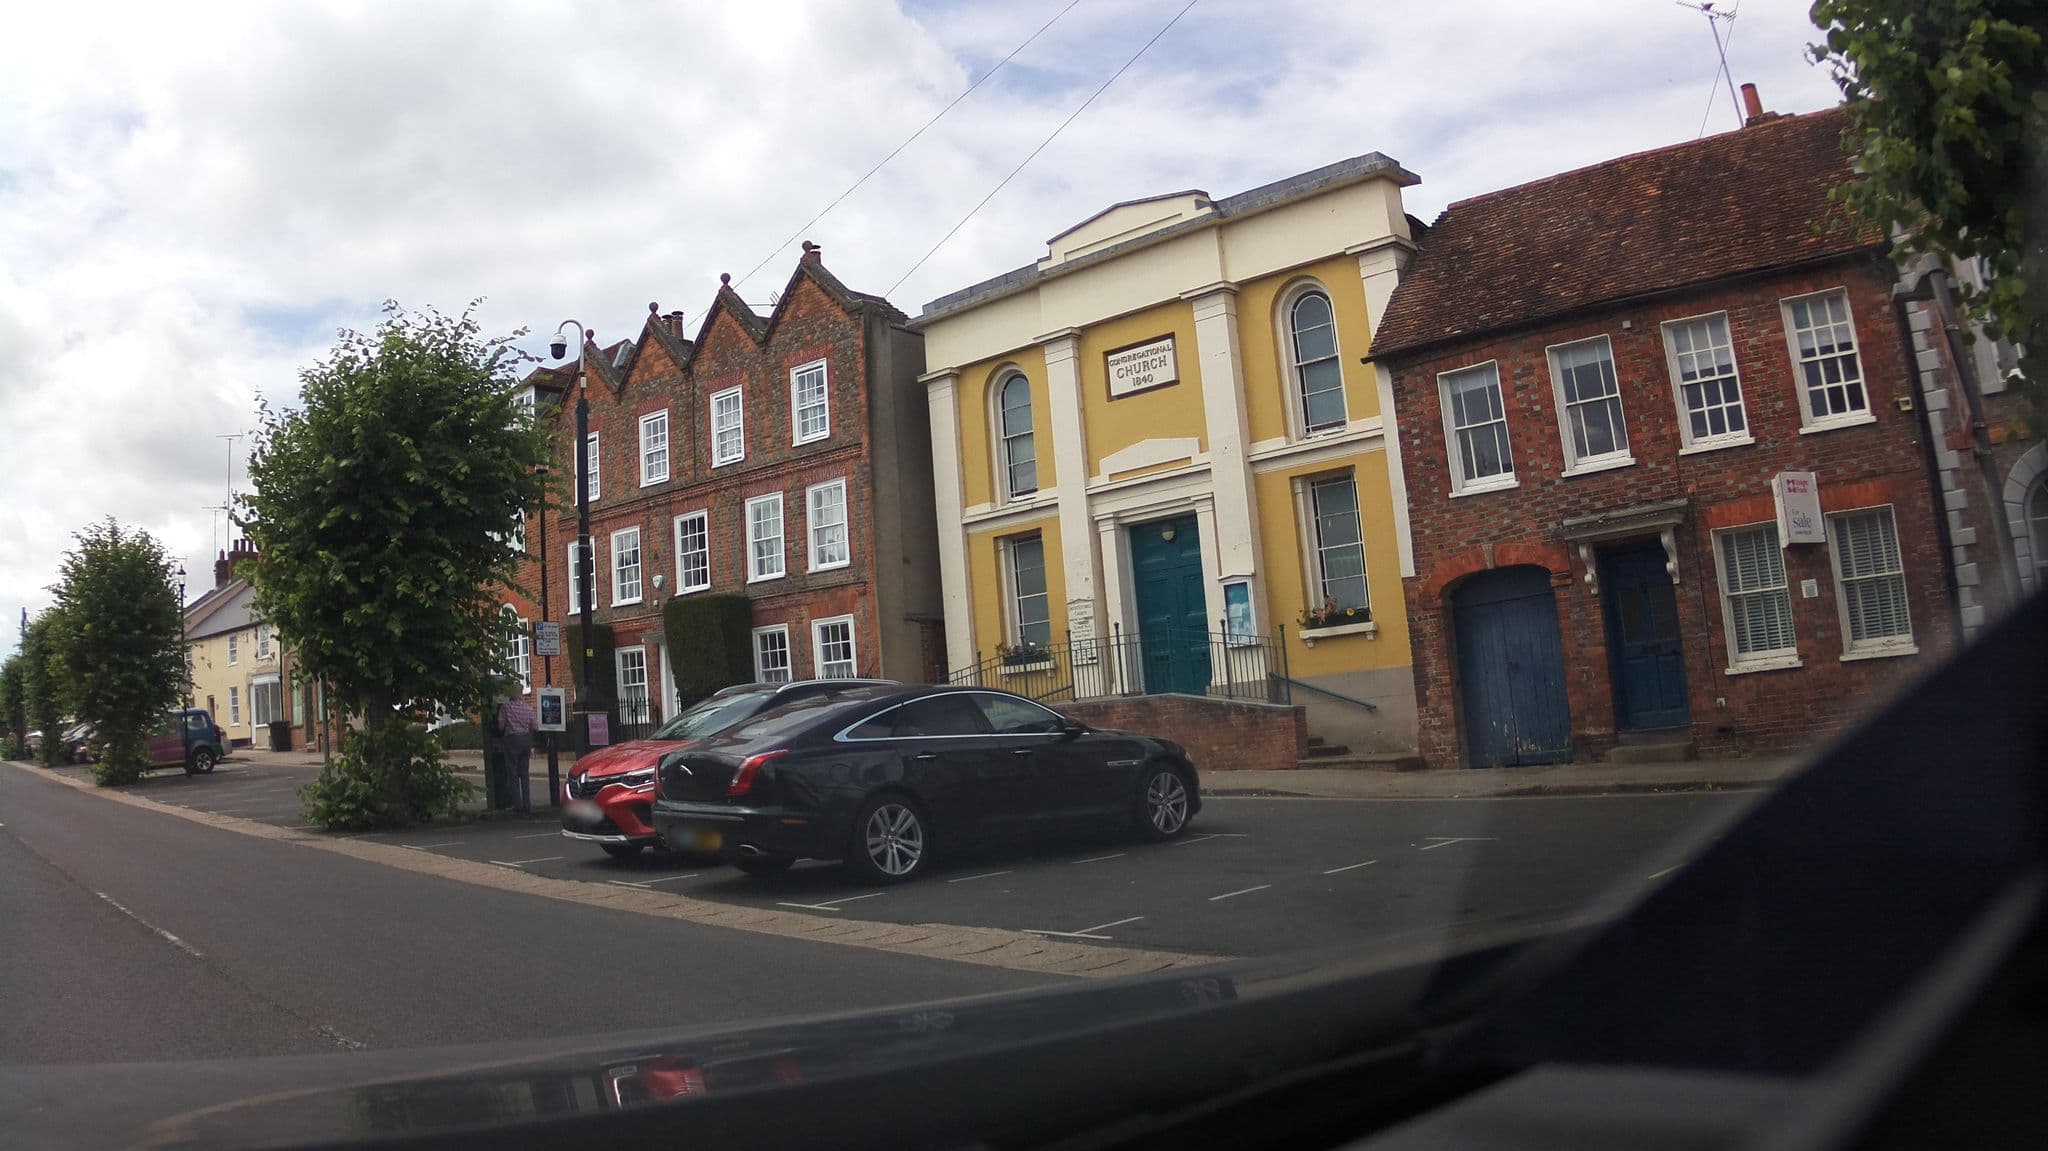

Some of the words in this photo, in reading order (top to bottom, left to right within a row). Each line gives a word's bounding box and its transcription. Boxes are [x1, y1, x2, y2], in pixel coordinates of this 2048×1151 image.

[1109, 343, 1172, 366] CONGREGATIONAL
[1116, 355, 1167, 379] CHURCH
[1132, 374, 1153, 387] 1840
